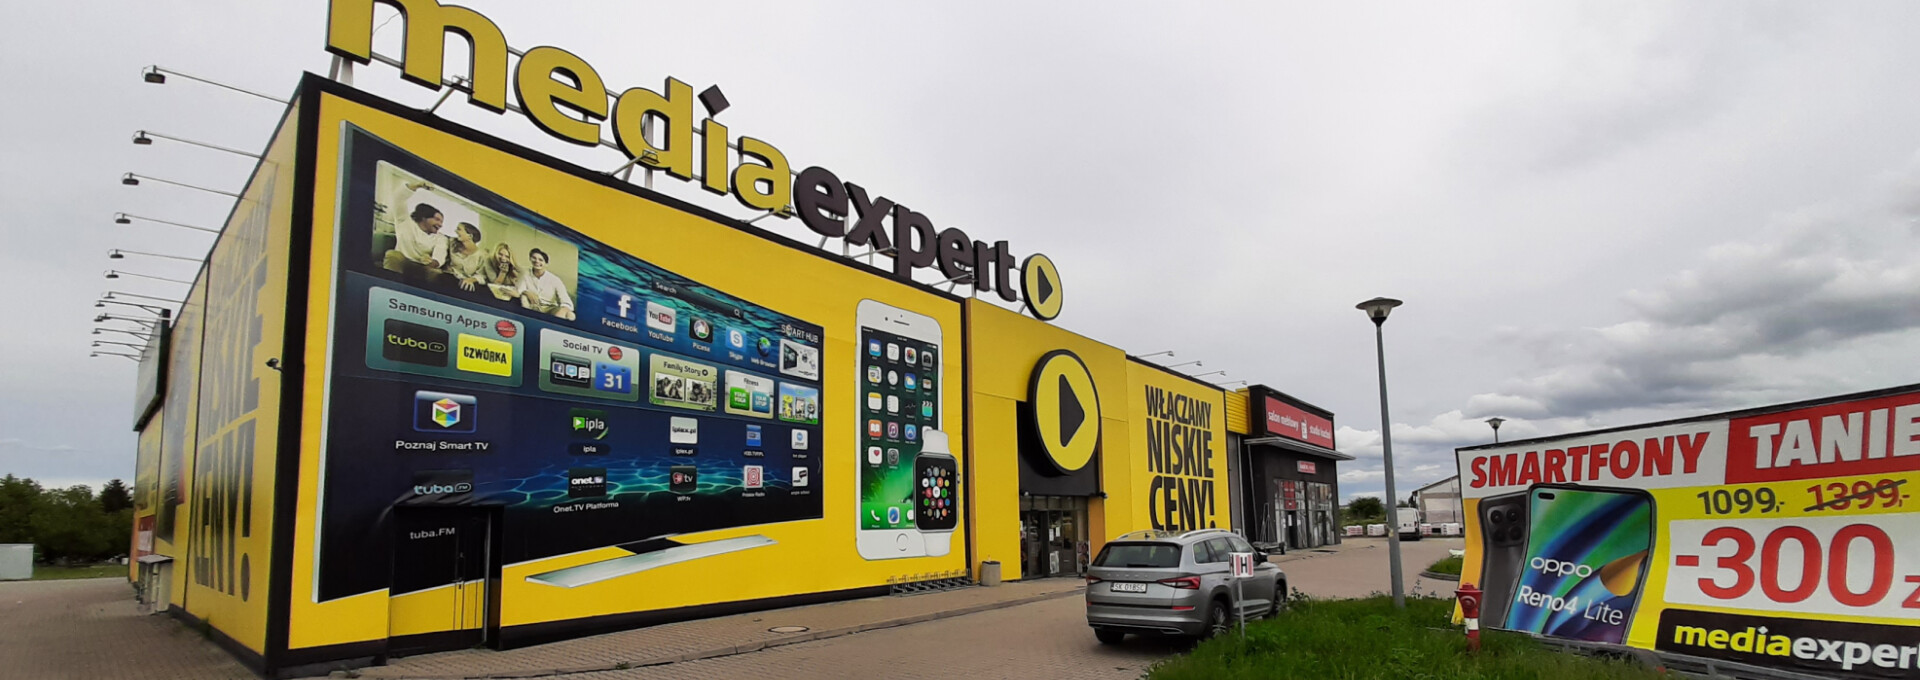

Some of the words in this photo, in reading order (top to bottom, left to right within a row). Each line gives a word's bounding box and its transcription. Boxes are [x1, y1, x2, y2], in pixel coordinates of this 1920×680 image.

[324, 0, 1017, 302] mediaexpert
[656, 282, 677, 294] Search
[388, 298, 453, 324] Samsung
[456, 314, 488, 330] Apps
[601, 317, 638, 333] Facebook
[387, 333, 428, 350] tuba
[648, 330, 674, 343] YouTube
[805, 332, 819, 343] HUB
[463, 345, 508, 364] CZWÓRKA
[563, 339, 589, 352] Social
[592, 345, 603, 354] TV
[663, 361, 683, 373] Family
[684, 366, 701, 377] Story
[603, 372, 623, 390] 31
[1145, 384, 1212, 430] WŁĄCZAMY
[585, 418, 605, 432] ipla
[395, 440, 436, 451] Poznaj
[439, 441, 472, 450] Smart
[475, 442, 489, 450] TV
[583, 445, 597, 454] ipla
[1146, 417, 1214, 479] NISKIE
[1470, 430, 1711, 490] SMARTFONY
[684, 474, 693, 483] tv
[414, 484, 454, 495] tuba
[553, 504, 585, 513] Onet.TV
[586, 502, 619, 510] Platforma
[1149, 475, 1216, 532] CENY!
[1697, 487, 1785, 515] 1099,-
[410, 527, 455, 540] tuba.FM
[1530, 556, 1593, 580] oppo
[1675, 523, 1895, 607] -300
[1114, 583, 1123, 591] SK
[1518, 585, 1578, 615] Reno4
[1583, 599, 1624, 628] Lite
[1673, 625, 1920, 671] mediaexper
